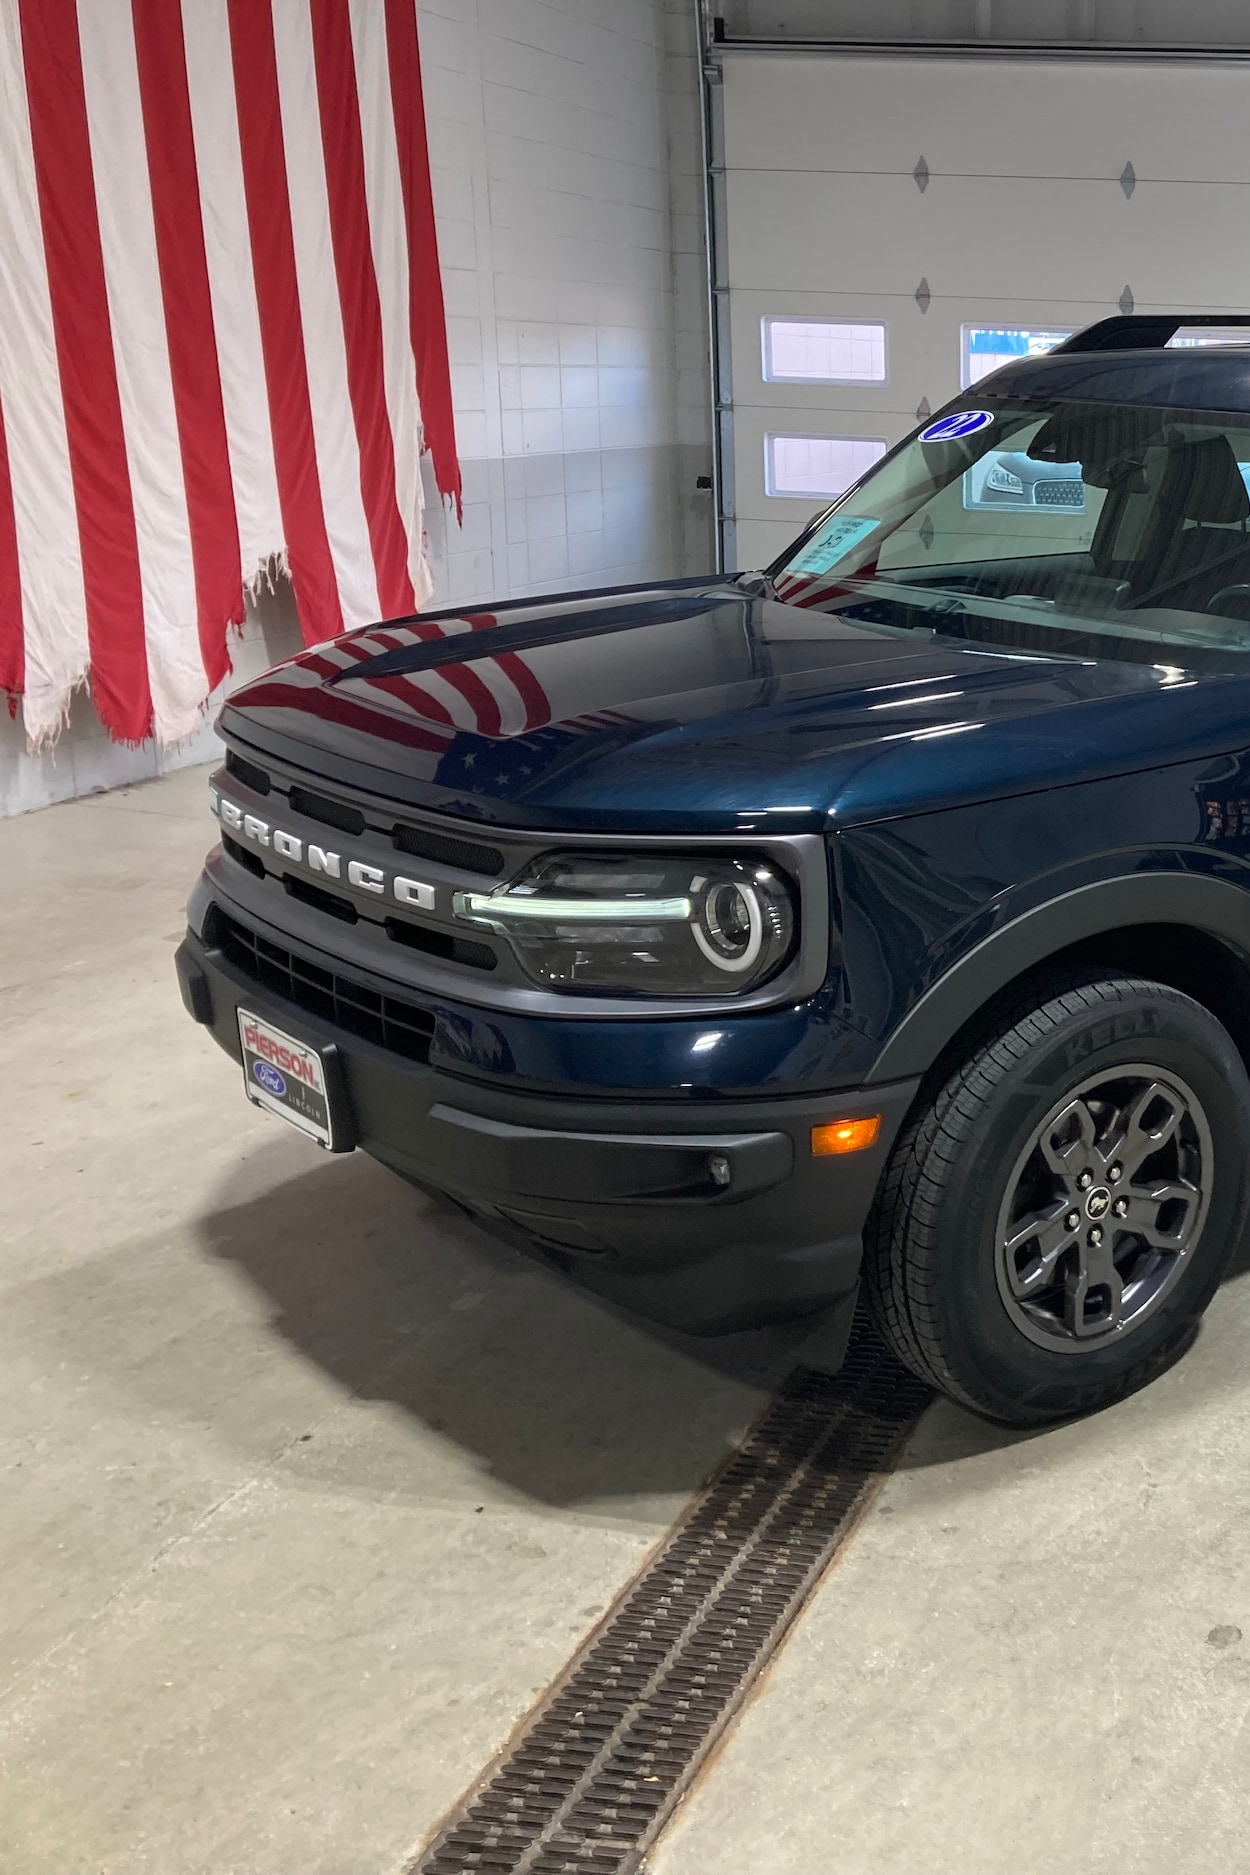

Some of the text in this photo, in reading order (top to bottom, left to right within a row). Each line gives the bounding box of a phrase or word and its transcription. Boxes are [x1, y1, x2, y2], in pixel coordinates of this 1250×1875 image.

[926, 413, 982, 439] 22
[221, 799, 436, 911] BRONCO
[244, 1025, 314, 1085] PIERSON
[260, 1064, 281, 1090] Ford
[288, 1094, 321, 1120] LINCOLN
